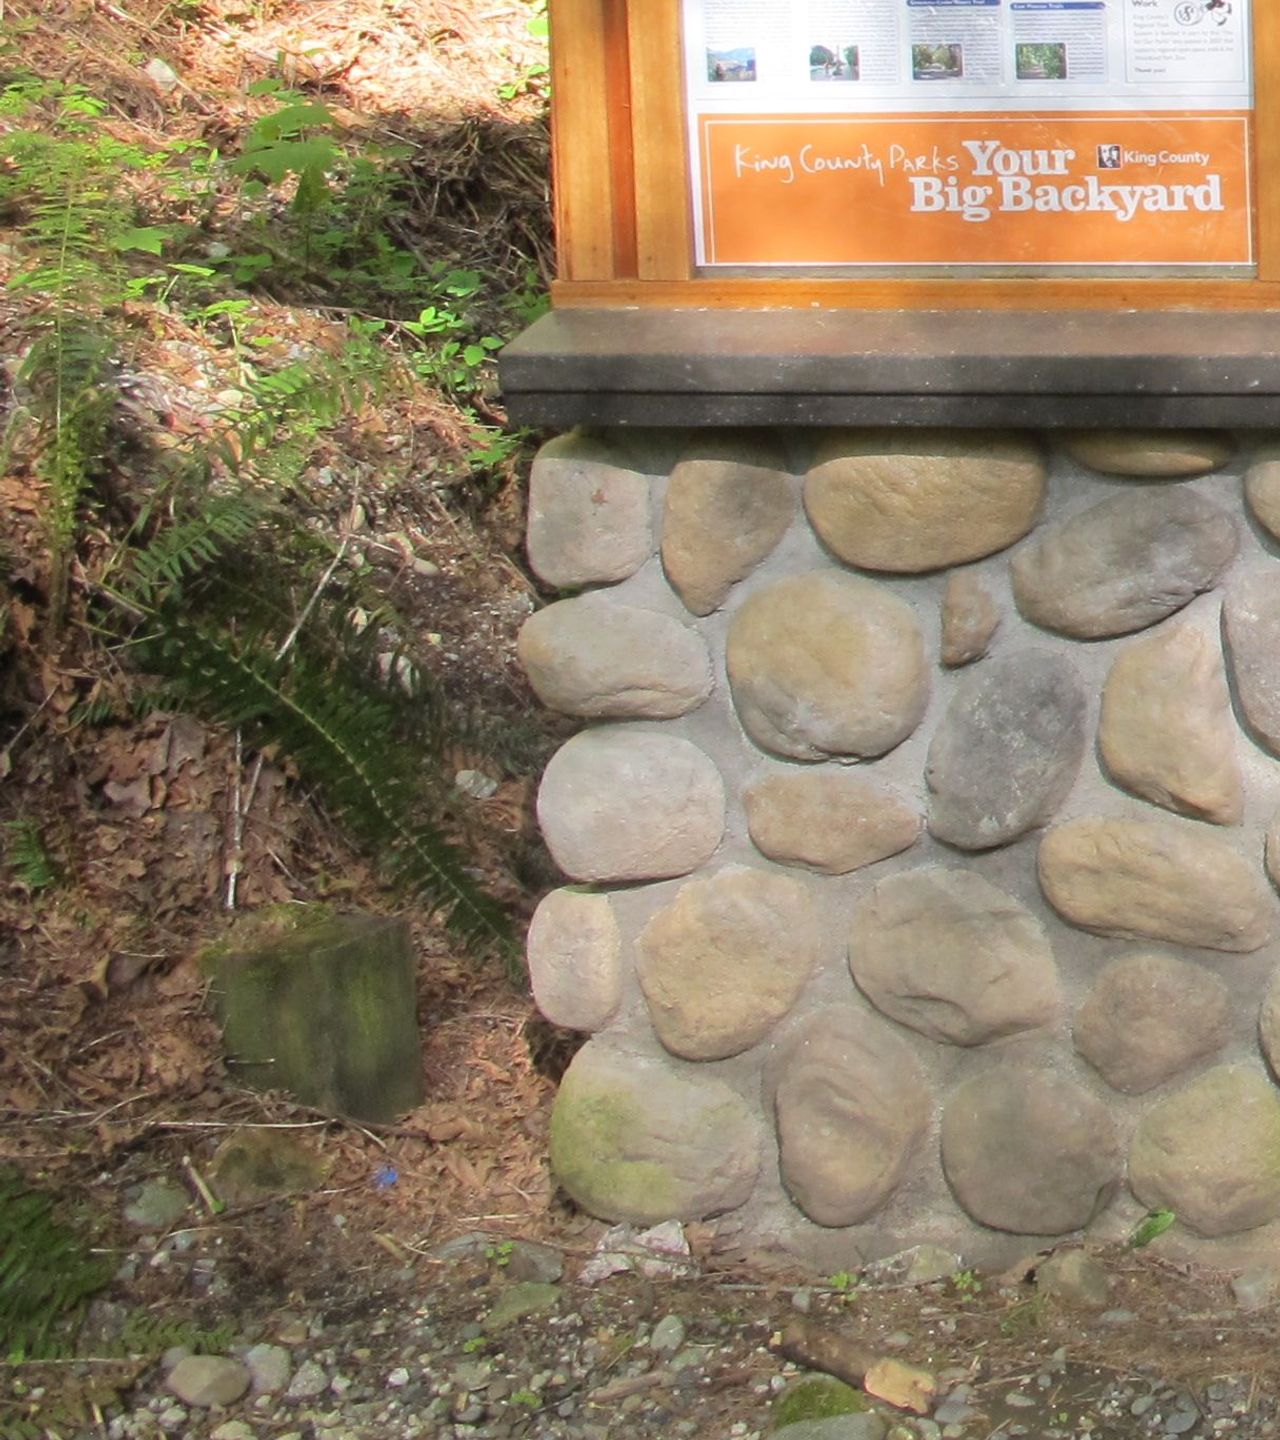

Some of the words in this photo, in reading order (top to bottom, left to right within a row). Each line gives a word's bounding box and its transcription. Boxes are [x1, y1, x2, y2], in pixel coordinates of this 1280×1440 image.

[961, 140, 1076, 176] Your
[1124, 150, 1157, 166] King
[1158, 150, 1211, 166] County
[909, 176, 993, 222] Big
[998, 175, 1225, 221] Backyard
